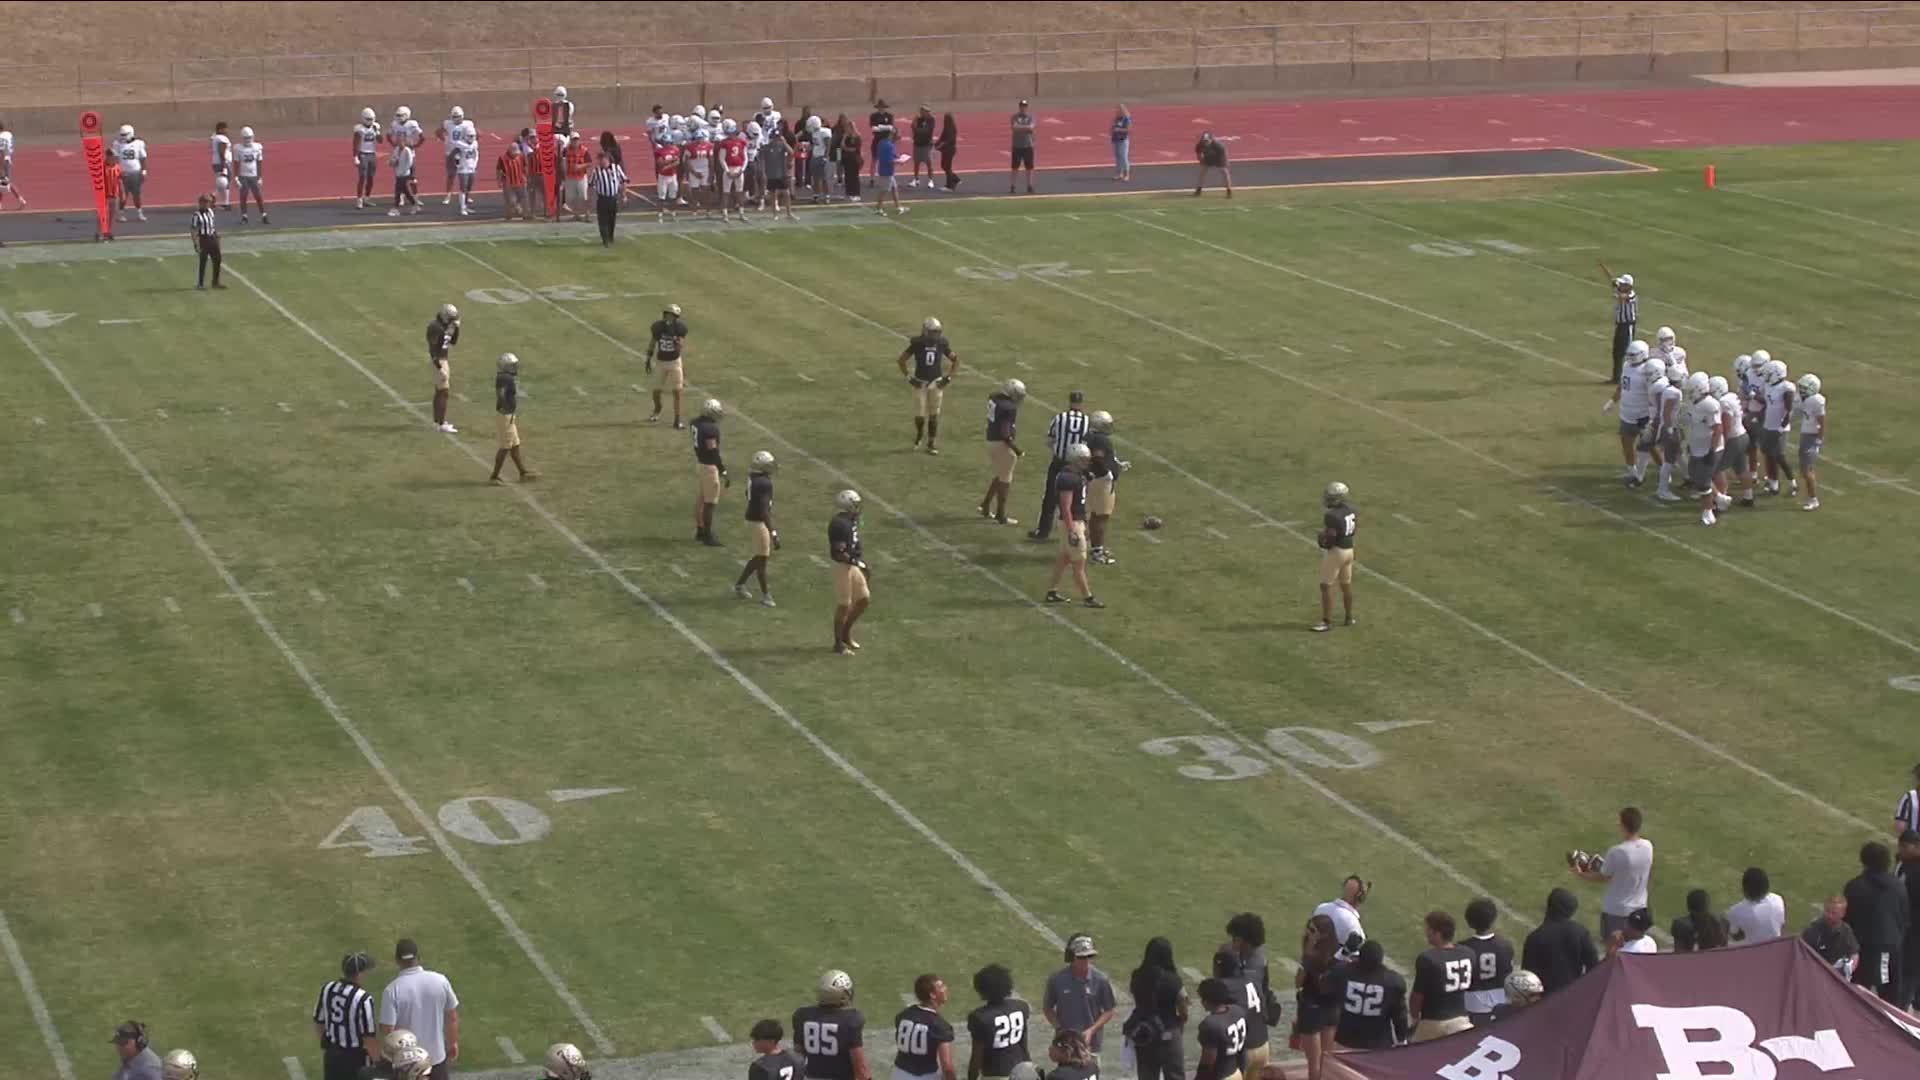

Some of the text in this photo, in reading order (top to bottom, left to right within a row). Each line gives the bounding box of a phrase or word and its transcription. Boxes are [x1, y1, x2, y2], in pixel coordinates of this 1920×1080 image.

[926, 351, 936, 366] 0
[1070, 416, 1082, 432] U
[1139, 726, 1383, 780] 30
[318, 796, 552, 857] 40
[1445, 958, 1472, 992] 53
[1479, 952, 1497, 980] 9
[330, 994, 347, 1024] S
[1246, 982, 1261, 1013] 4
[1344, 980, 1385, 1016] 52
[803, 1021, 839, 1056] 85
[899, 1020, 929, 1055] 80
[993, 1011, 1025, 1049] 28
